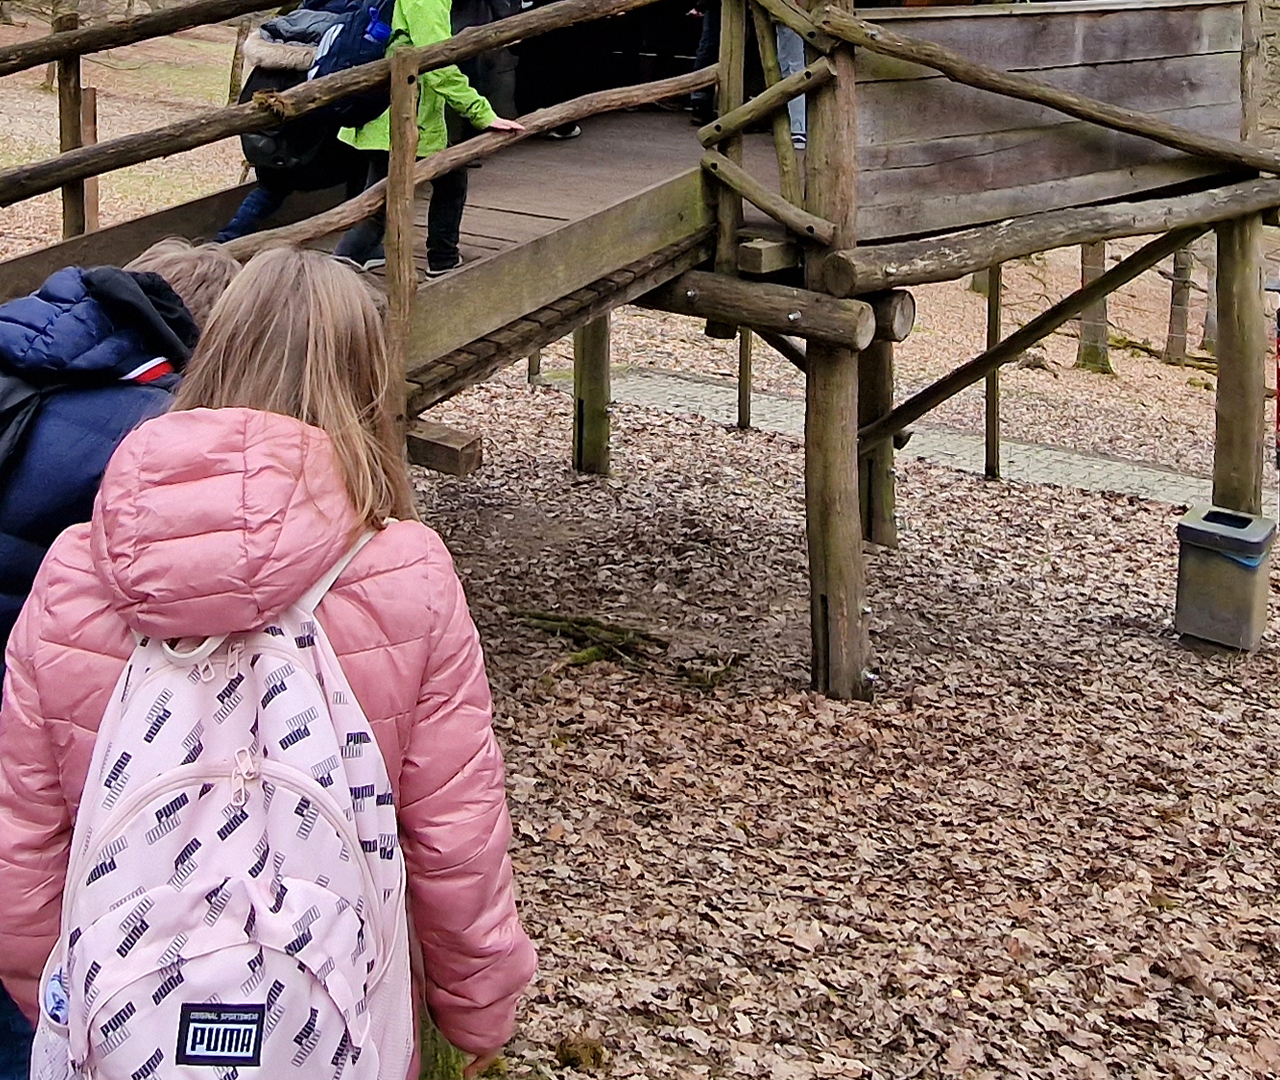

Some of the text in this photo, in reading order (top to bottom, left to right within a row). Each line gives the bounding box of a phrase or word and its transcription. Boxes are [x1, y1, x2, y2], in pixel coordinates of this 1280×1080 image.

[143, 708, 172, 744] PUMA
[279, 724, 310, 751] PUMA
[104, 751, 132, 789] PUMA
[154, 792, 190, 823] PUMA
[216, 808, 249, 841] PUMA
[116, 919, 150, 958] PUMA
[151, 970, 185, 1006] PUMA
[100, 1001, 137, 1038] PUMA
[191, 1026, 253, 1052] PUMA
